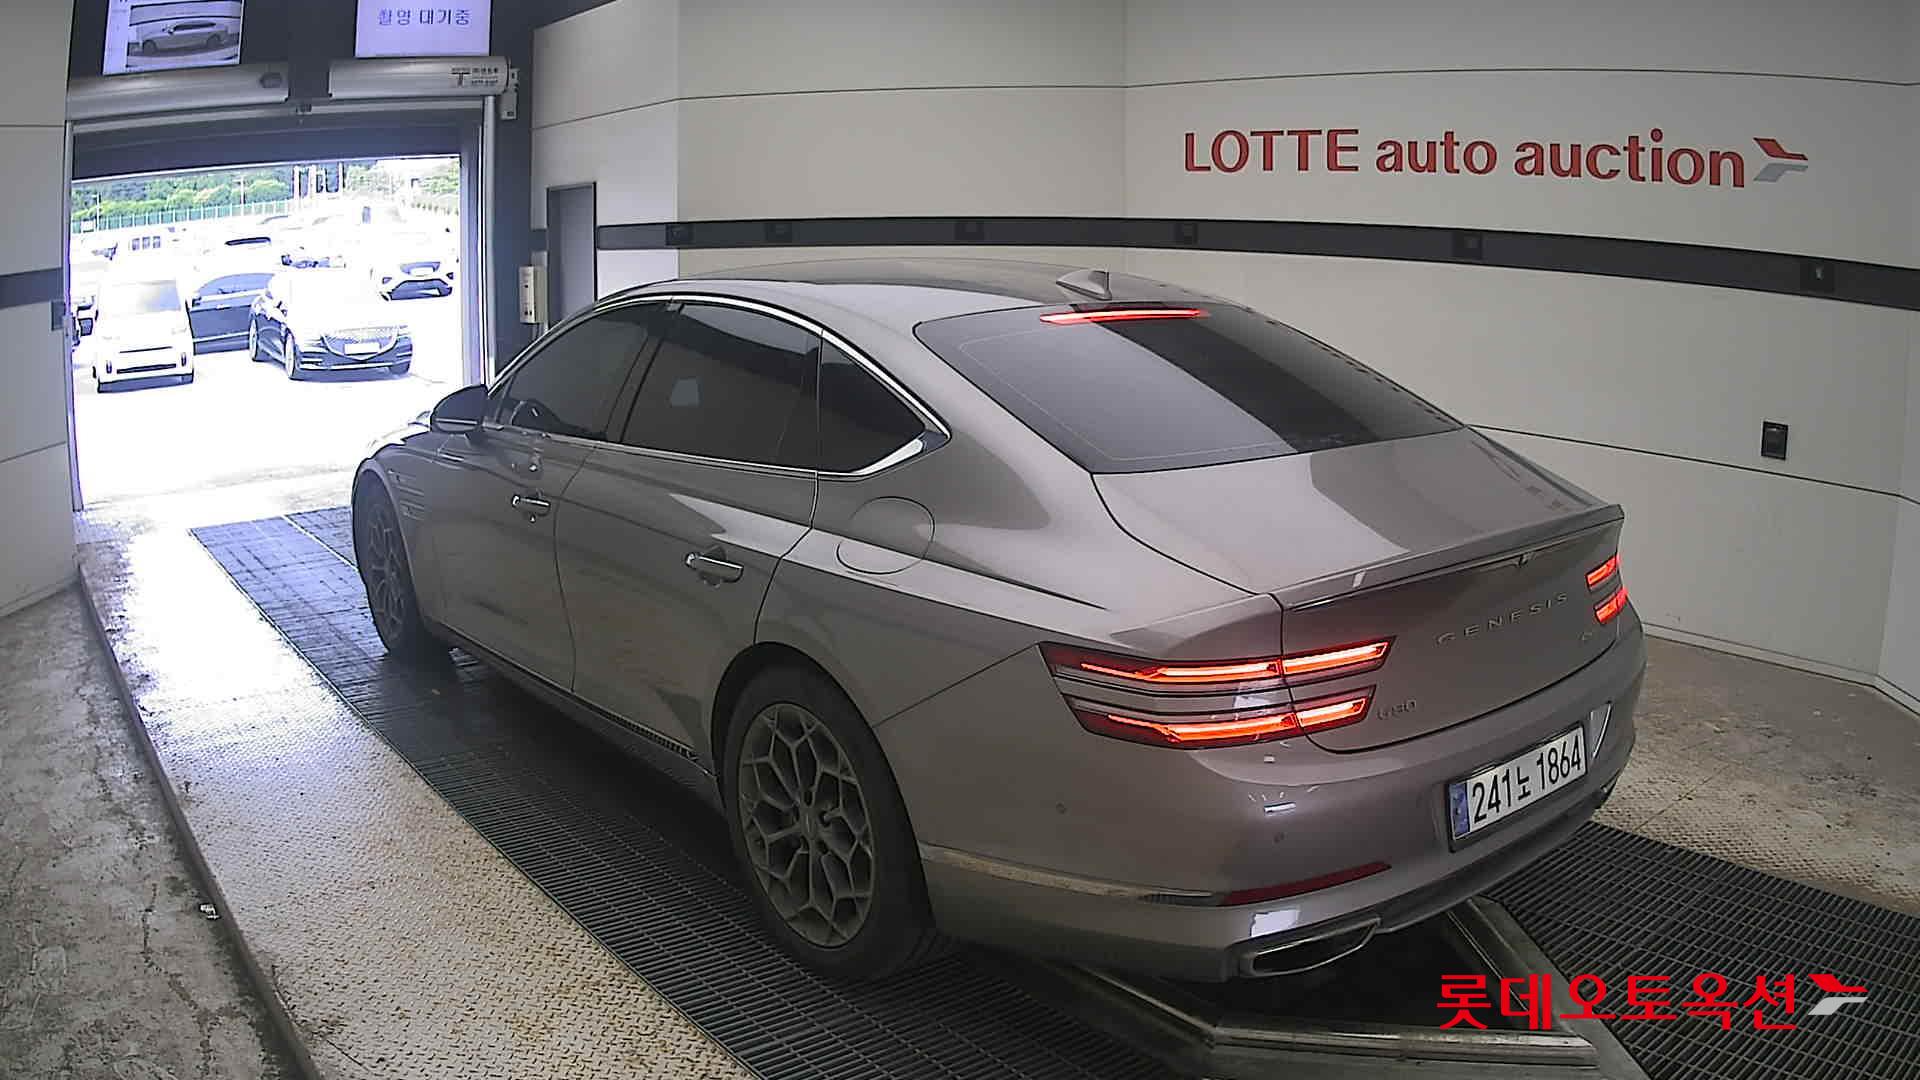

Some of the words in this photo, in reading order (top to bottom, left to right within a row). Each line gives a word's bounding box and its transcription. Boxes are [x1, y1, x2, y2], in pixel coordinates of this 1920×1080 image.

[419, 8, 471, 26] 대기중
[1184, 128, 1360, 172] LOTTE
[1375, 130, 1498, 174] auto
[1513, 128, 1746, 188] auction
[1435, 592, 1568, 645] GENESIS
[1472, 766, 1532, 824] 241노
[1536, 734, 1581, 790] 1864
